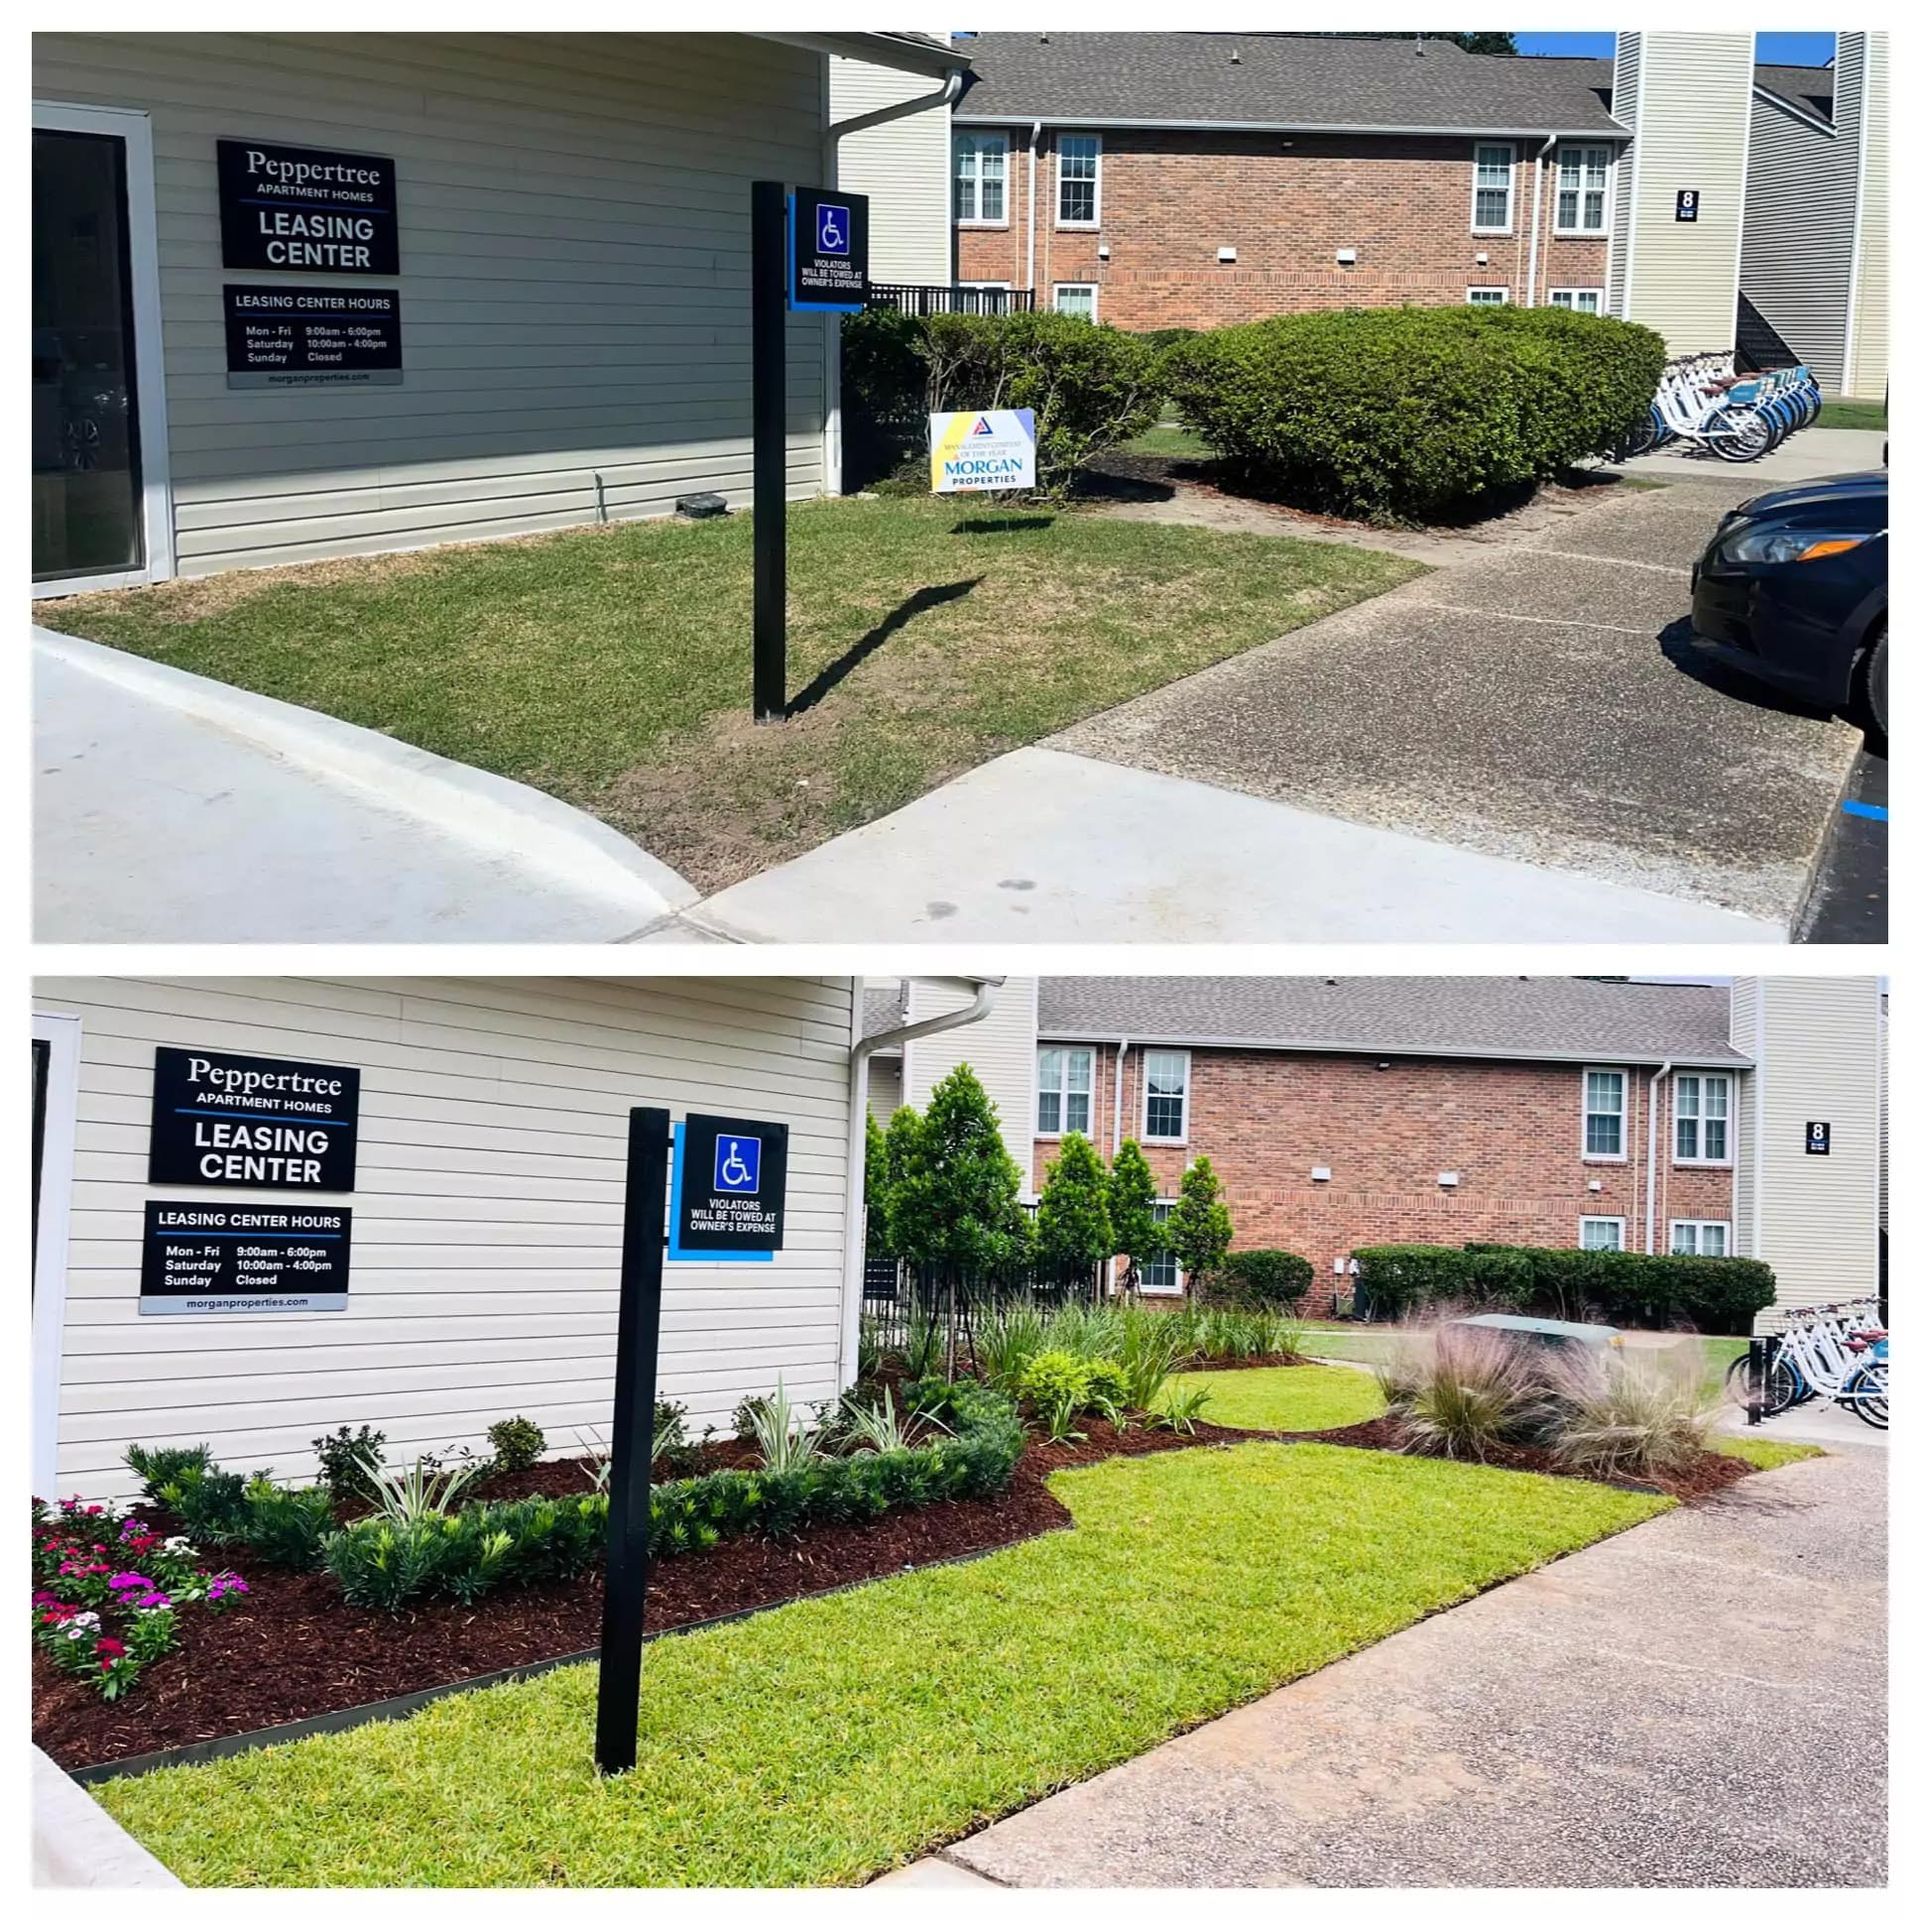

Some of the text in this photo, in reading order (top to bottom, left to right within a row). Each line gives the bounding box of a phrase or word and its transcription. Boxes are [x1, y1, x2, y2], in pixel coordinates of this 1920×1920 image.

[247, 151, 381, 186] Peppertree
[257, 183, 374, 203] APARTMENT HOMES
[1683, 192, 1693, 208] 8
[259, 211, 374, 240] LEASING
[266, 240, 371, 267] CENTER
[814, 259, 851, 270] VIOLATORS
[801, 268, 818, 277] WILL
[830, 270, 853, 279] TOWED
[802, 277, 862, 288] OWNER'S EXPENSE
[236, 295, 390, 310] LEASING CENTER HOURS
[246, 326, 269, 336] Mon
[278, 326, 291, 336] Fri
[305, 327, 340, 336] 9:00am
[348, 327, 381, 338] 6:00pm
[247, 339, 294, 351] Saturday
[307, 339, 346, 349] 10:00am
[354, 339, 387, 350] 4:00pm
[248, 352, 342, 363] Sunday Closed
[268, 373, 370, 384] morganproperties.com
[945, 458, 1022, 475] MORGAN
[953, 476, 1016, 485] PROPERTIES
[187, 1057, 342, 1096] Peppertree
[196, 1092, 332, 1114] APARTMENT HOMES
[195, 1122, 329, 1154] LEASING
[1813, 1124, 1823, 1140] 8
[200, 1153, 321, 1183] CENTER
[709, 1198, 760, 1211] VIOLATORS
[158, 1212, 341, 1228] LEASING CENTER HOURS
[691, 1209, 776, 1222] WILL BE TOWED AT
[690, 1220, 775, 1233] OWNER'S EXPENSE
[166, 1246, 193, 1256] Mon
[204, 1246, 220, 1256] Fri
[236, 1247, 278, 1257] 9:00am
[286, 1247, 326, 1260] 6:00pm
[166, 1260, 221, 1273] Saturday
[236, 1260, 283, 1270] 10:00am
[292, 1260, 332, 1273] 4:00pm
[164, 1274, 278, 1288] Sunday Closed
[186, 1297, 308, 1311] morganproperties.com
